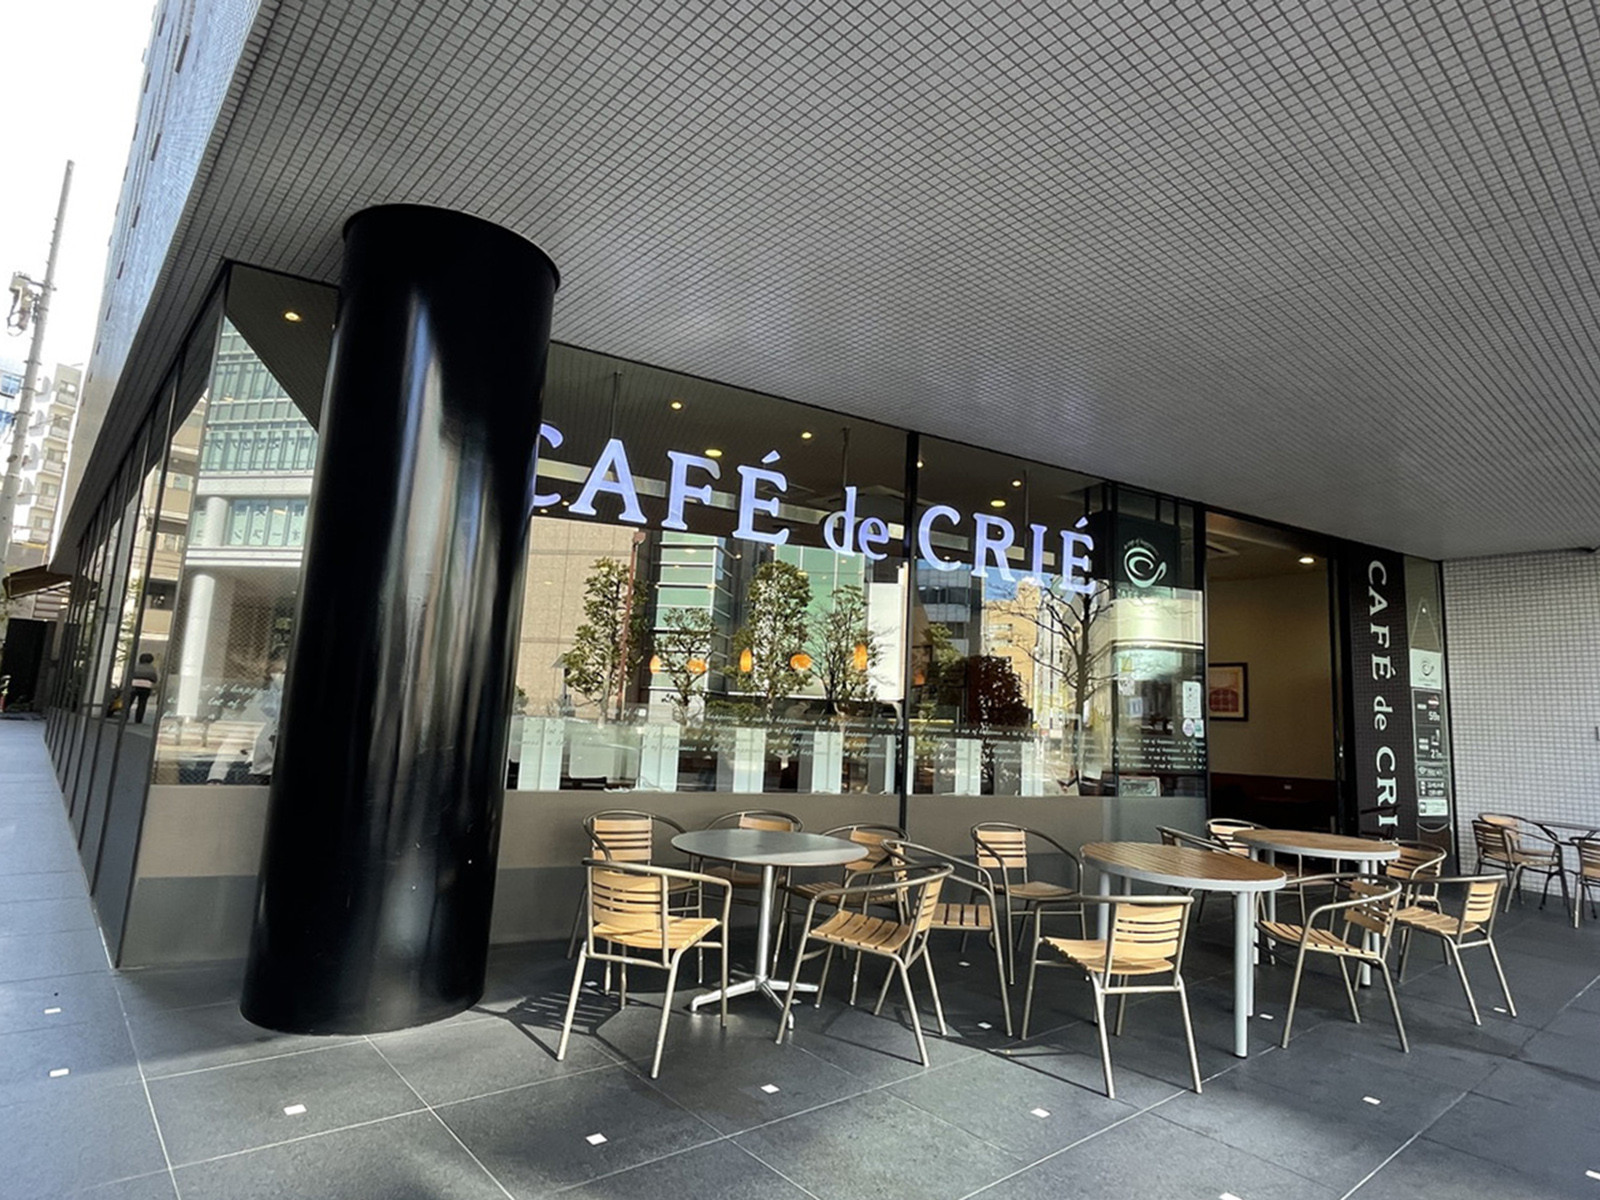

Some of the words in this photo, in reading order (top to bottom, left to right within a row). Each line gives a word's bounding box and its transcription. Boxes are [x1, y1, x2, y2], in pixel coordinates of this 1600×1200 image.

[823, 486, 890, 561] de
[917, 505, 1097, 595] CRIÉ
[1368, 560, 1396, 681] CAFÉ
[1373, 695, 1394, 731] de
[1376, 746, 1399, 846] CRI
